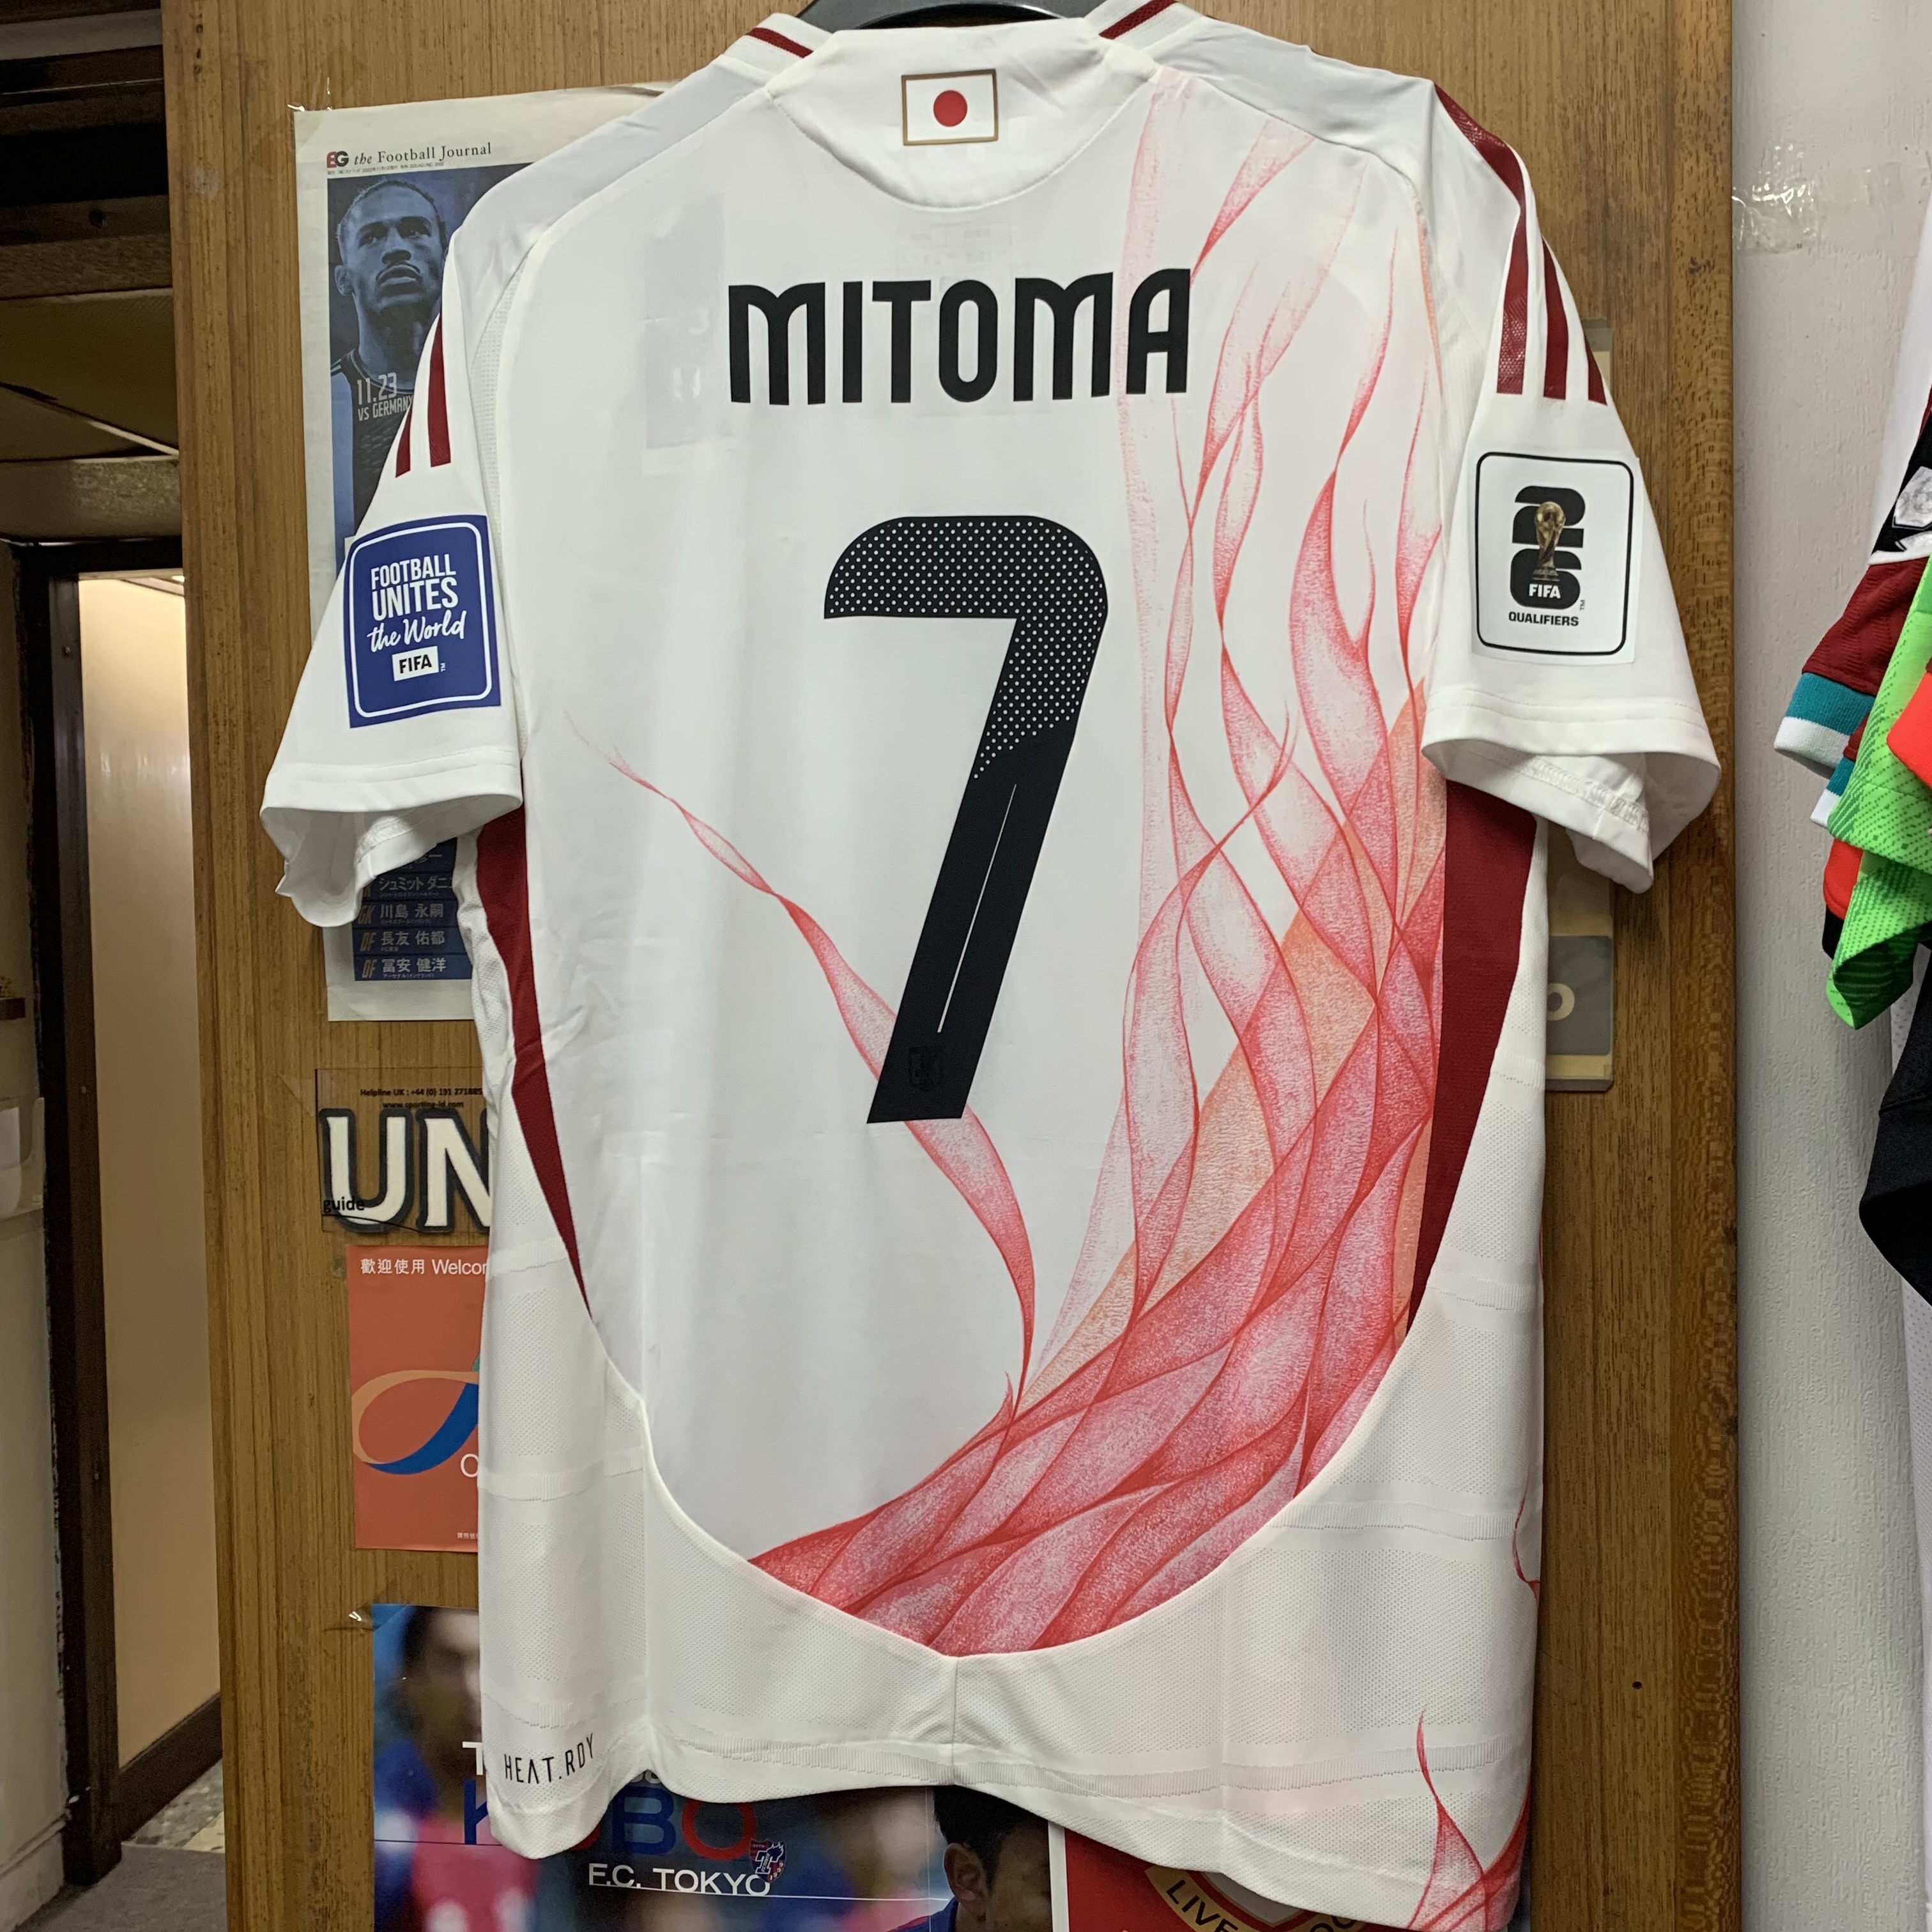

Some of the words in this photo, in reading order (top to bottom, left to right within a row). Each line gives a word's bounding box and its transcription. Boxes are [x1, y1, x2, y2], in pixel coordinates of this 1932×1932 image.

[354, 153, 372, 166] the
[378, 147, 436, 164] Football
[440, 142, 492, 161] Journal
[728, 268, 1190, 406] MITOMA
[356, 372, 397, 405] 11.23
[358, 407, 369, 421] VS
[373, 395, 413, 418] GERMANY
[371, 554, 456, 590] FOOTBALL
[372, 577, 459, 621] UNITES
[1529, 584, 1561, 599] FIFA
[1508, 611, 1579, 626] QUALIFIERS
[367, 623, 401, 652] the
[403, 610, 467, 645] World
[399, 654, 433, 674] FIFA
[824, 516, 1108, 1123] 7
[427, 875, 452, 890] ダニ
[380, 904, 409, 919] 川島
[415, 903, 443, 918] 永嗣
[381, 931, 410, 946] 長友
[415, 931, 445, 946] 佑都
[417, 957, 447, 972] 健洋
[360, 1089, 391, 1097] Helpline
[323, 1197, 365, 1213] guide
[360, 1259, 425, 1275] 歡迎使用
[504, 1732, 594, 1784] HEAT.RDY
[588, 1864, 641, 1888] F.C.
[653, 1868, 770, 1896] TOKYO
